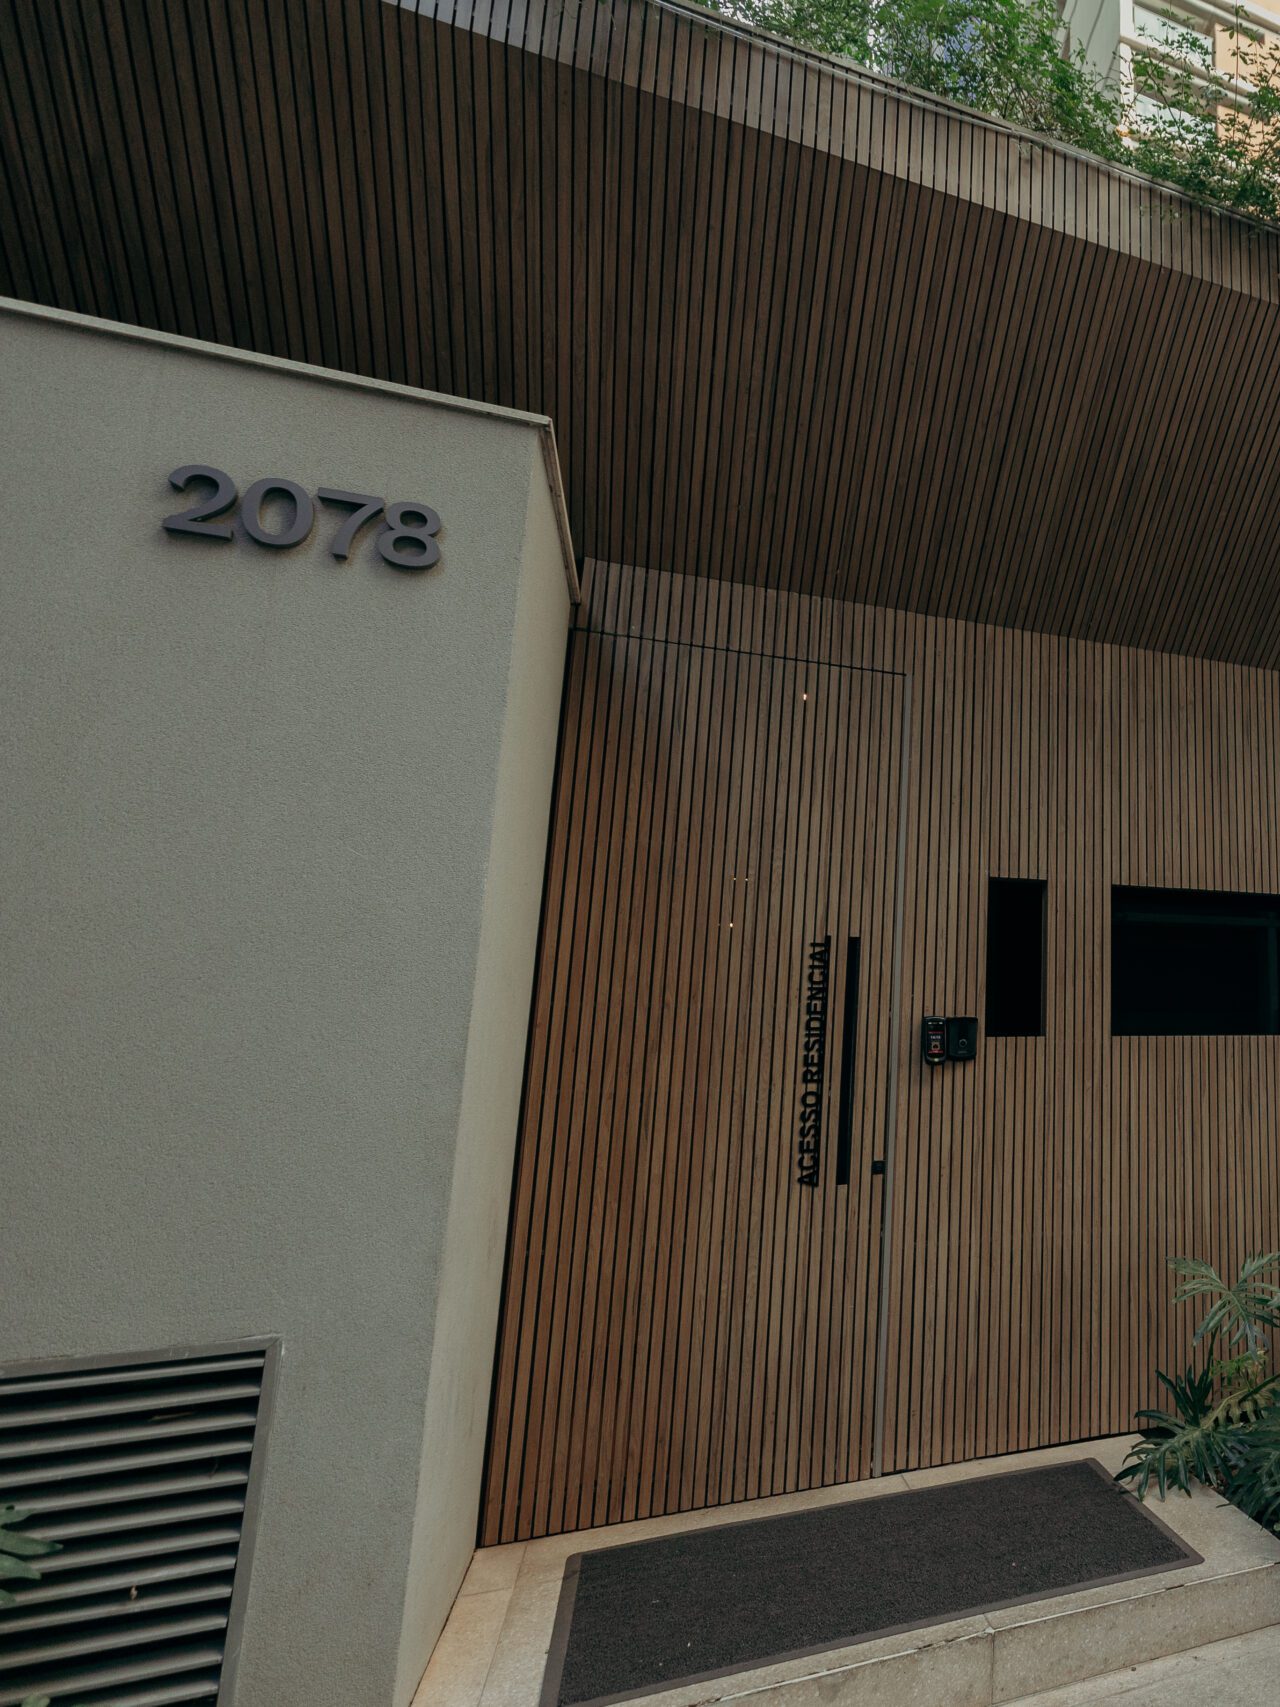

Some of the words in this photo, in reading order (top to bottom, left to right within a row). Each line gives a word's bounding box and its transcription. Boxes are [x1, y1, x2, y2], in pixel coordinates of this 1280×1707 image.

[162, 464, 441, 570] 2078
[802, 935, 831, 1084] RESIDENCIAL
[797, 1090, 822, 1187] ACESSO
